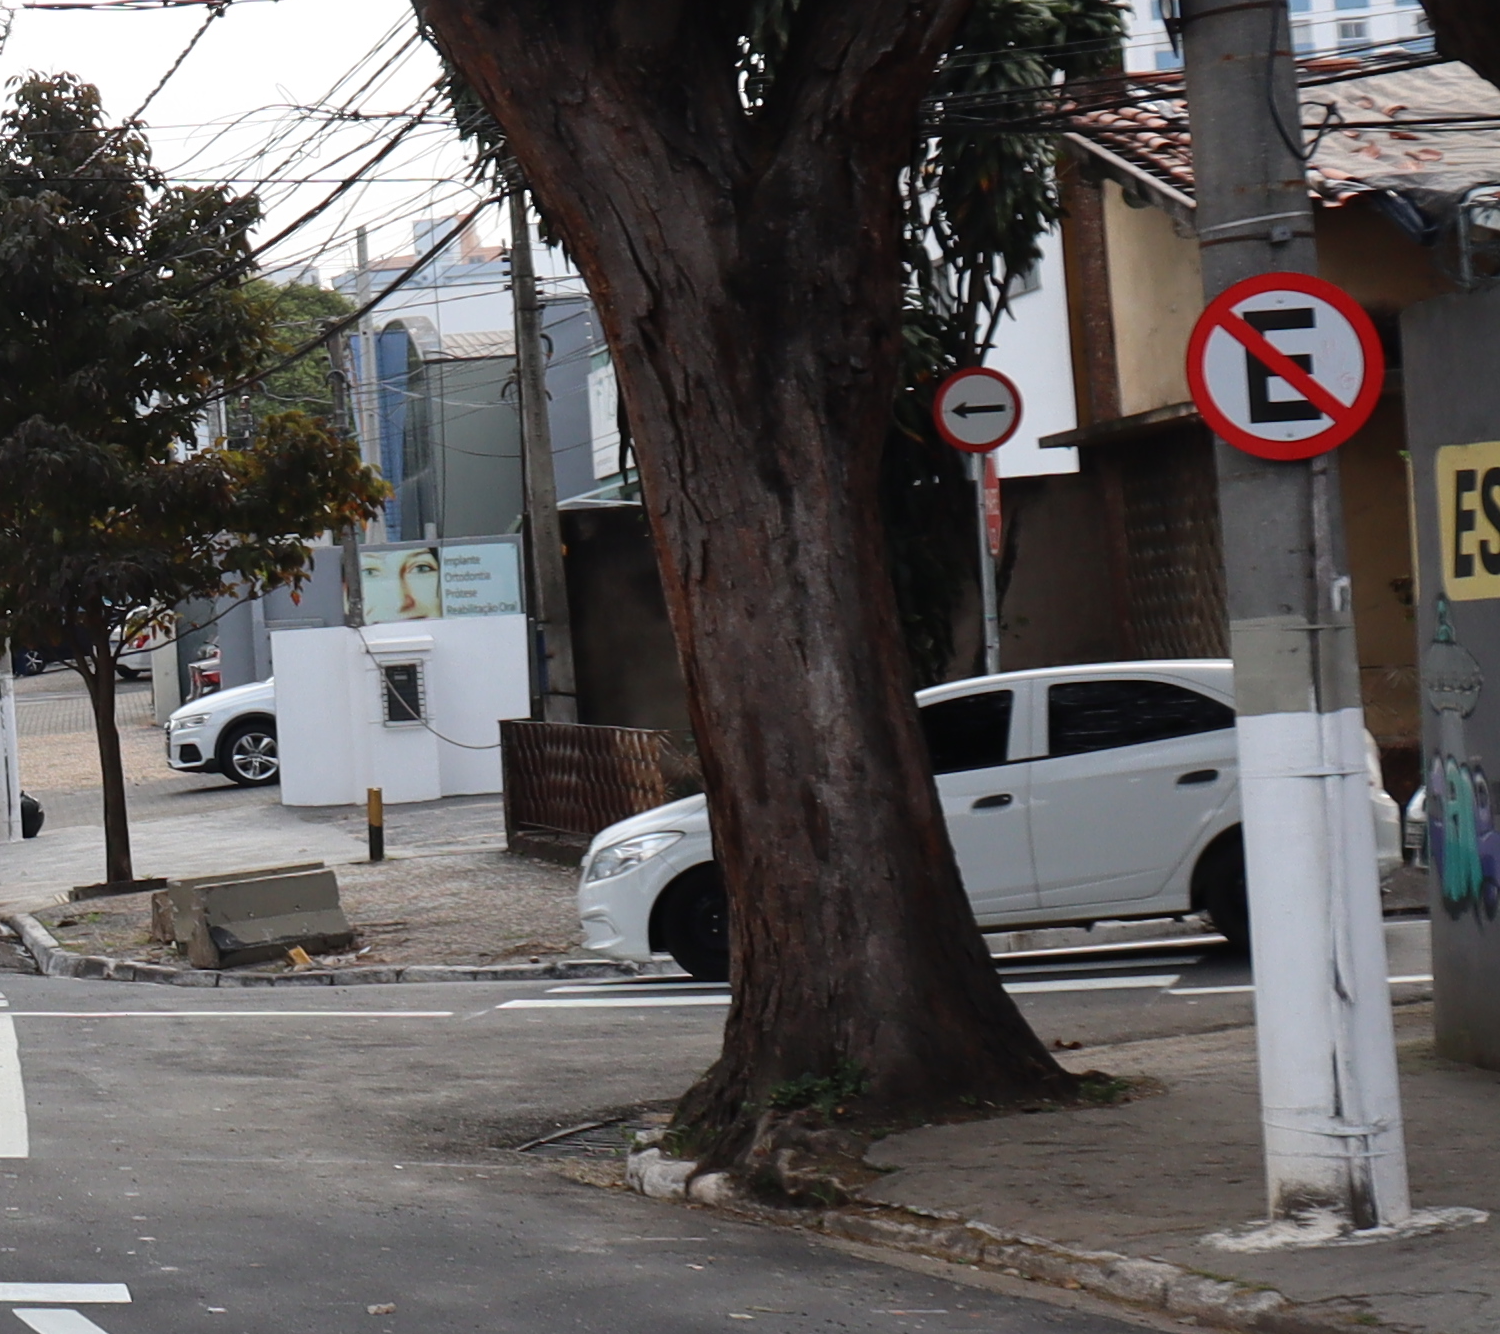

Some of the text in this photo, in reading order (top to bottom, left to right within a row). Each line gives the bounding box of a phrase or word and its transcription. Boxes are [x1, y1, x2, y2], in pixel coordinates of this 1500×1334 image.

[443, 556, 481, 567] Implante
[444, 571, 491, 583] Ortodontia
[445, 588, 478, 598] Prótese
[446, 601, 517, 615] Reabilitação Oral
